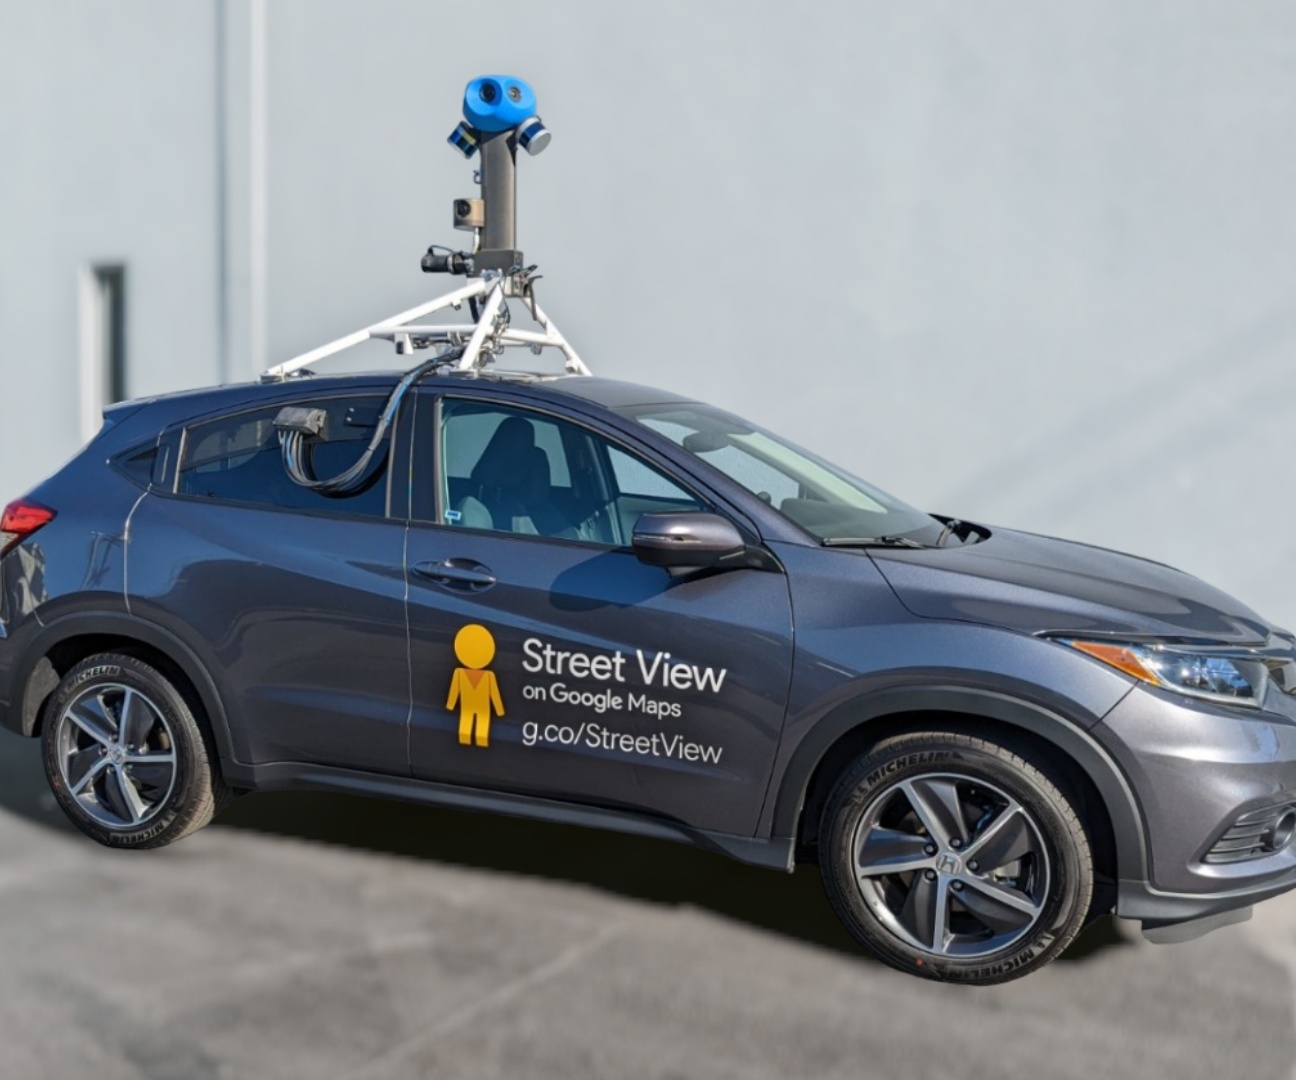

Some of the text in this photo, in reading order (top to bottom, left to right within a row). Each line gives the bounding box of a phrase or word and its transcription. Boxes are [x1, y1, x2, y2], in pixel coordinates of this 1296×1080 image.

[522, 637, 727, 693] Street View
[522, 682, 682, 720] on Google Maps
[522, 722, 723, 764] g.co/StreetView
[867, 751, 949, 786] MICHELIN
[948, 948, 1035, 980] MICHELIN
